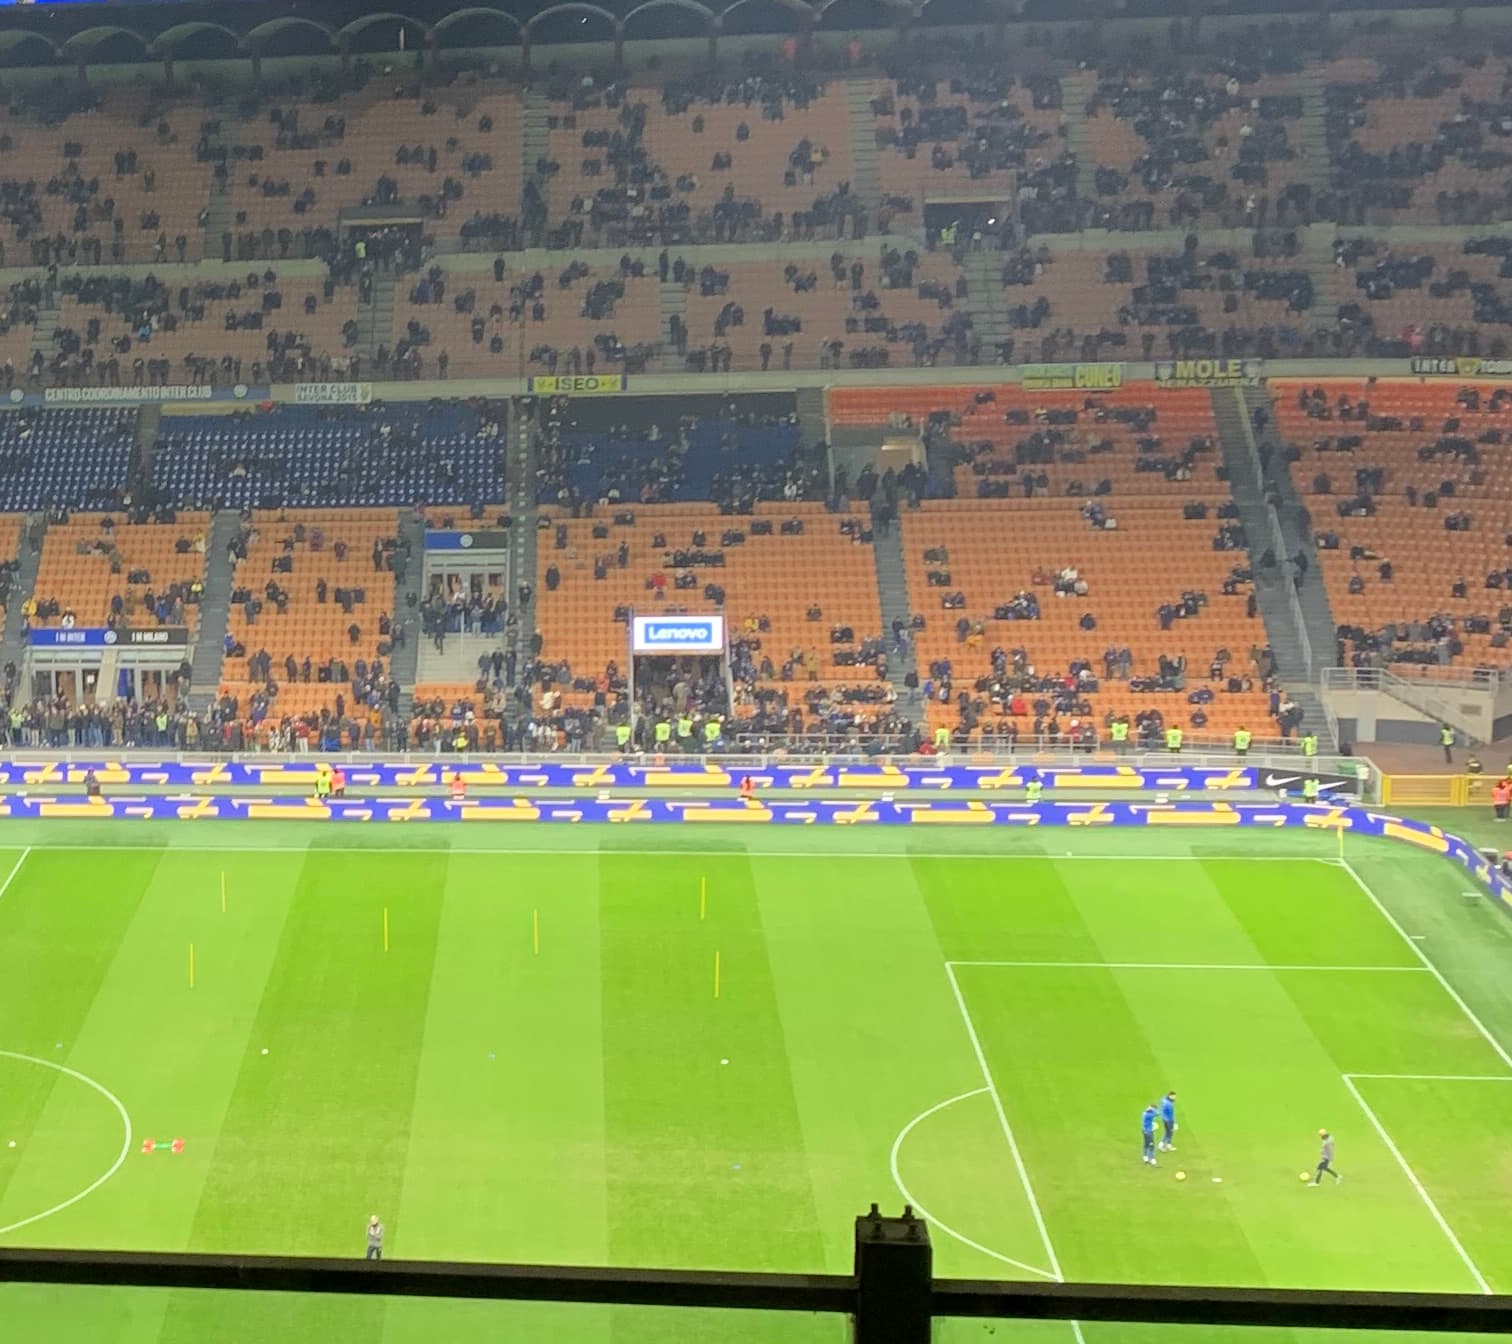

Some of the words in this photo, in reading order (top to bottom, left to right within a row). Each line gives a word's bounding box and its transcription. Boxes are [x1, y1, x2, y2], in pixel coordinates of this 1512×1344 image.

[1175, 359, 1242, 379] MOLE
[296, 383, 328, 394] INTER
[554, 377, 599, 391] ISEO
[188, 385, 212, 399] CLUB
[648, 625, 708, 640] Lenovo
